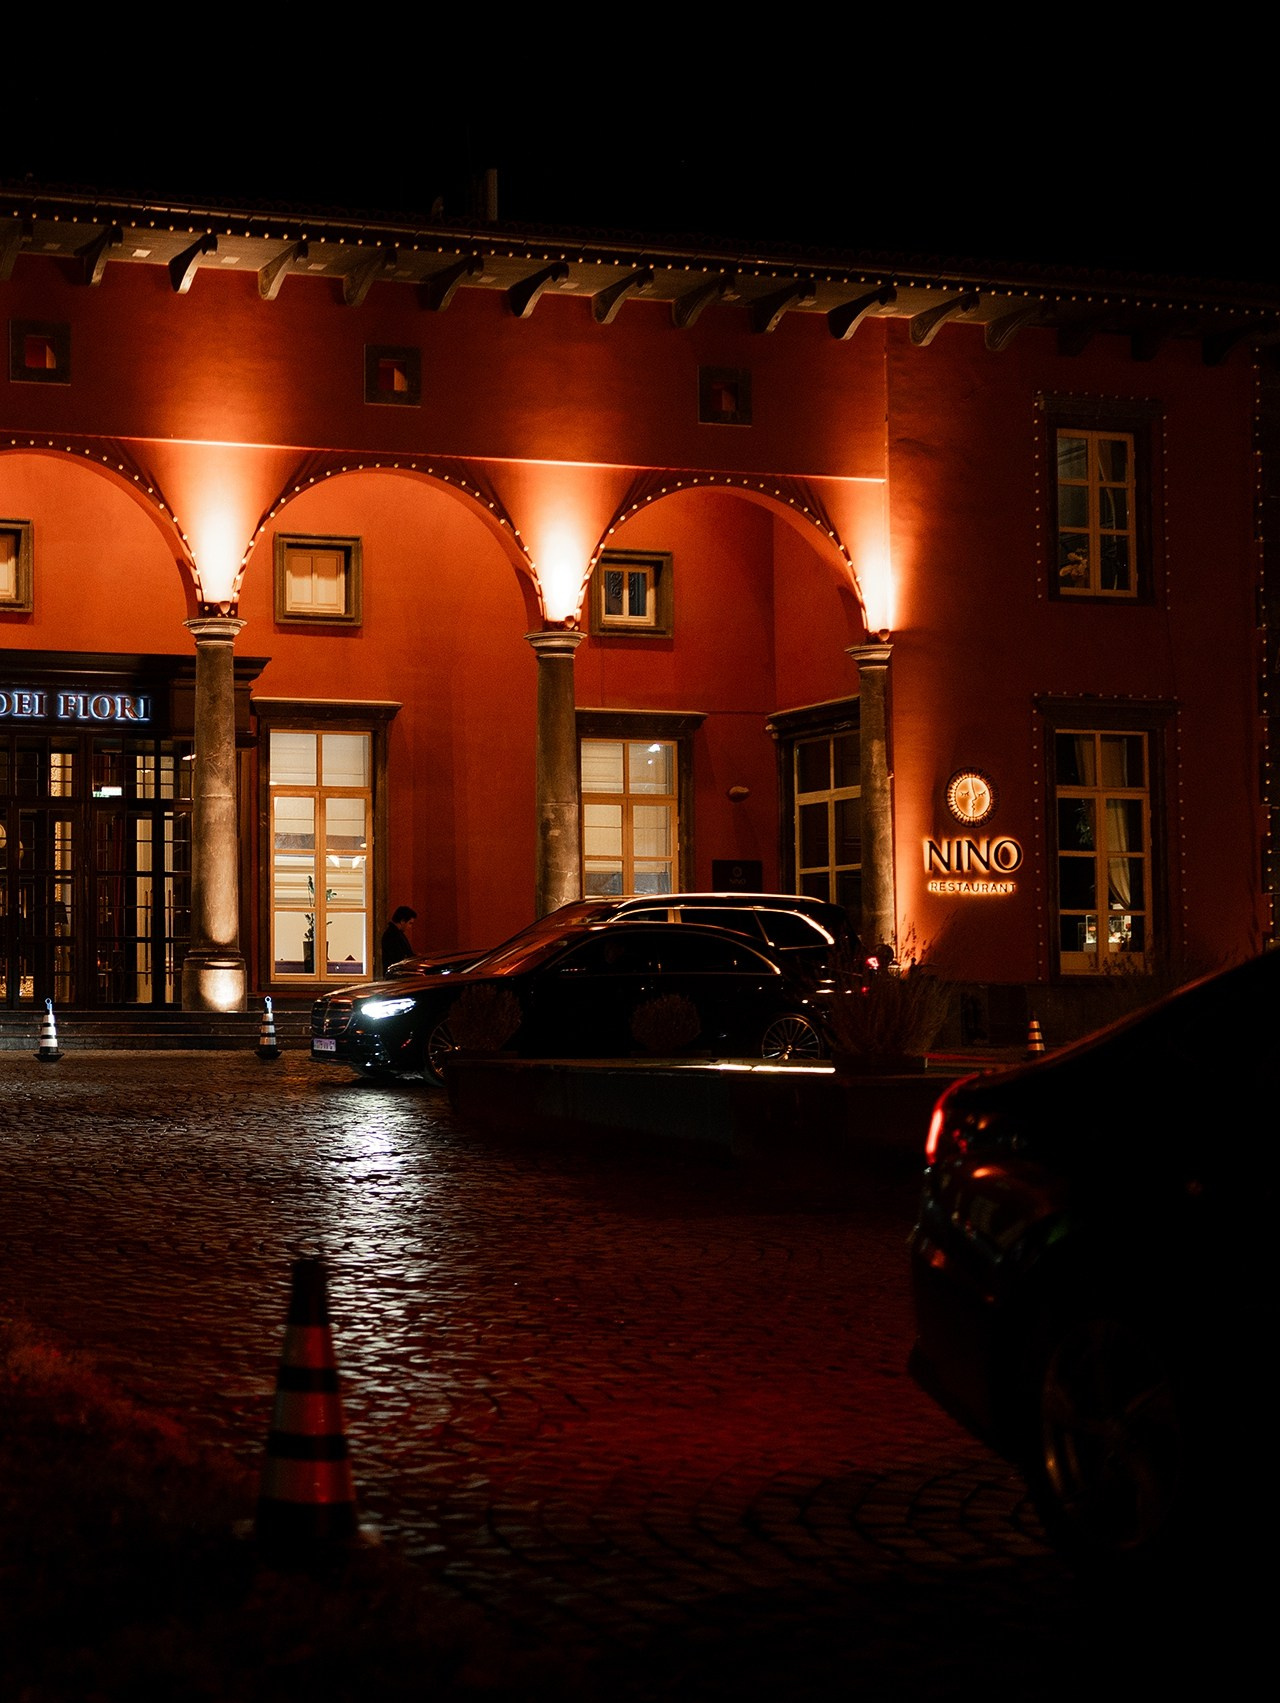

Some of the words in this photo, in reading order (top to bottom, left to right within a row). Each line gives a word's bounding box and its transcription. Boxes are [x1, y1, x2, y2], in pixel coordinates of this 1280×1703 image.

[58, 693, 152, 720] FIORI
[923, 837, 1023, 873] NINO
[928, 881, 1017, 894] RESTAURANT
